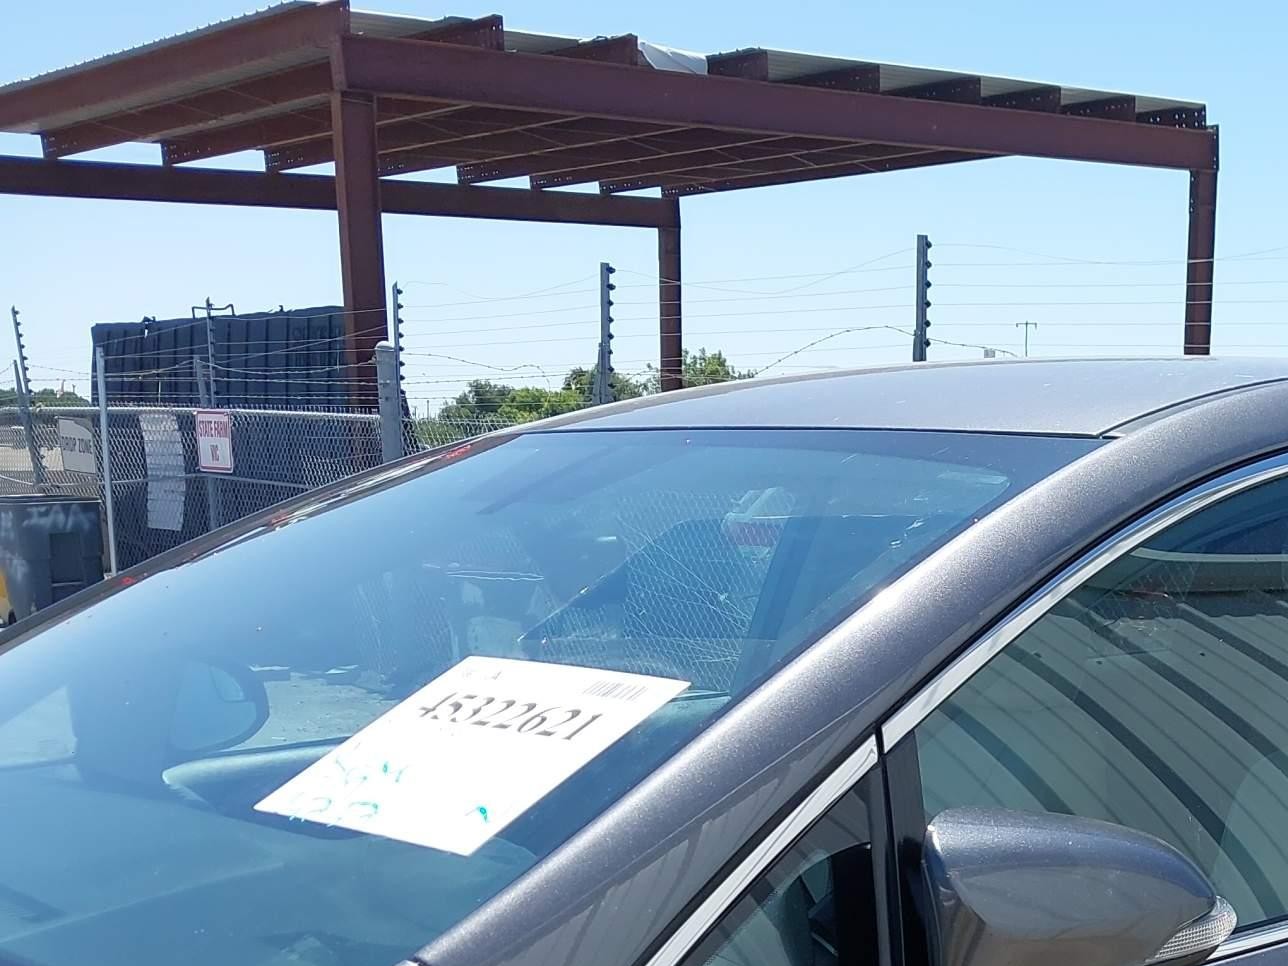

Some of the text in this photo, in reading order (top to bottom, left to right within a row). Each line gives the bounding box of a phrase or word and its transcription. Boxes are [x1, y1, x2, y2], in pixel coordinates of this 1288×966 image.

[199, 420, 228, 438] STATE FARM
[418, 692, 604, 741] 45322621
